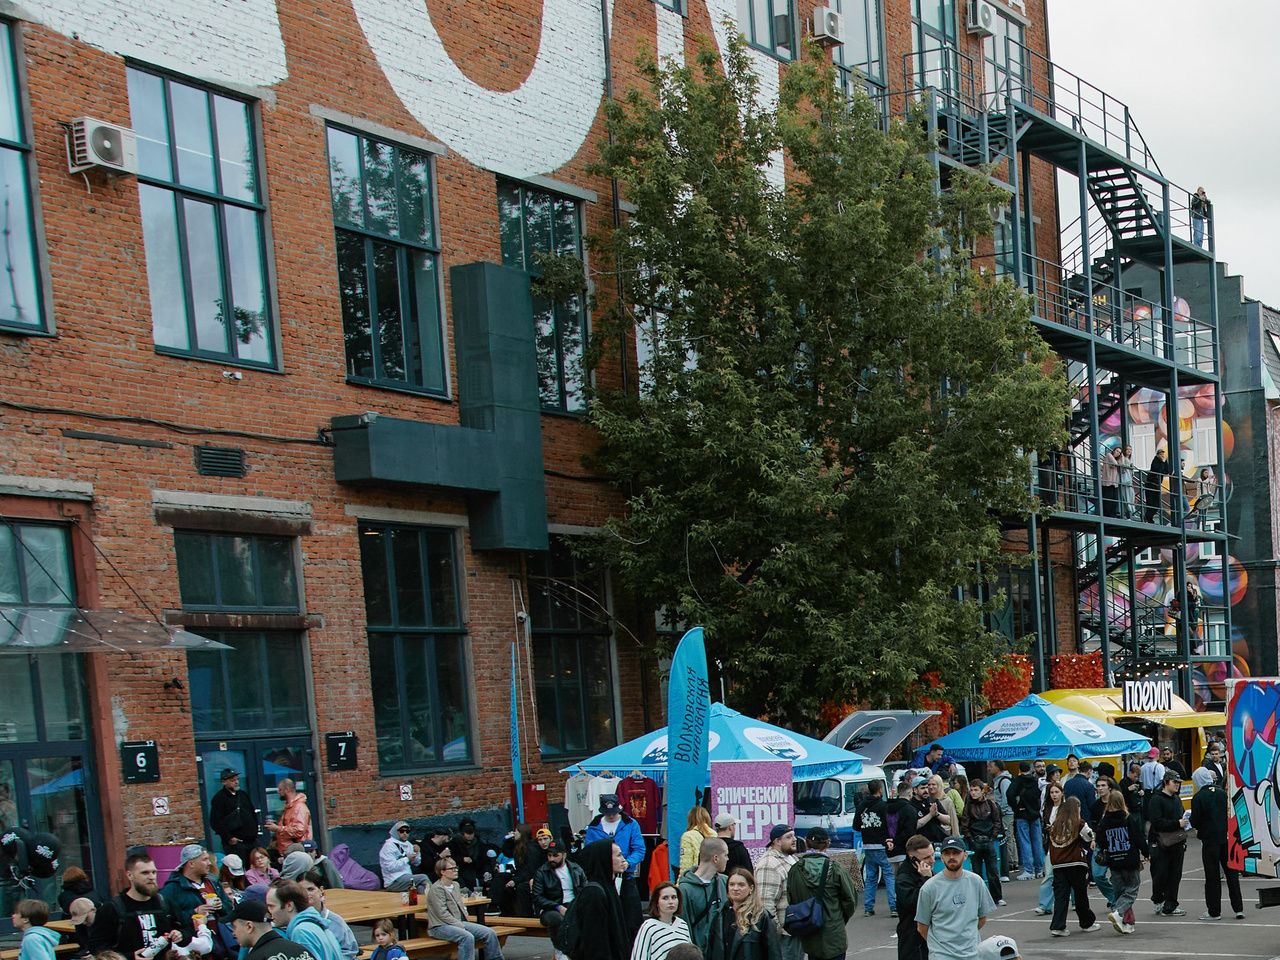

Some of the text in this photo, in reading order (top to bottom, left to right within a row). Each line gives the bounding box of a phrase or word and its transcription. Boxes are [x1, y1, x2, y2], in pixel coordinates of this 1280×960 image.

[674, 665, 697, 763] ВОЛКОВСКАЯ
[692, 676, 710, 765] ПИВОВАРНЯ
[136, 752, 147, 767] 6
[338, 742, 347, 756] 7
[717, 783, 788, 804] ЭПИЧЕСКИЙ
